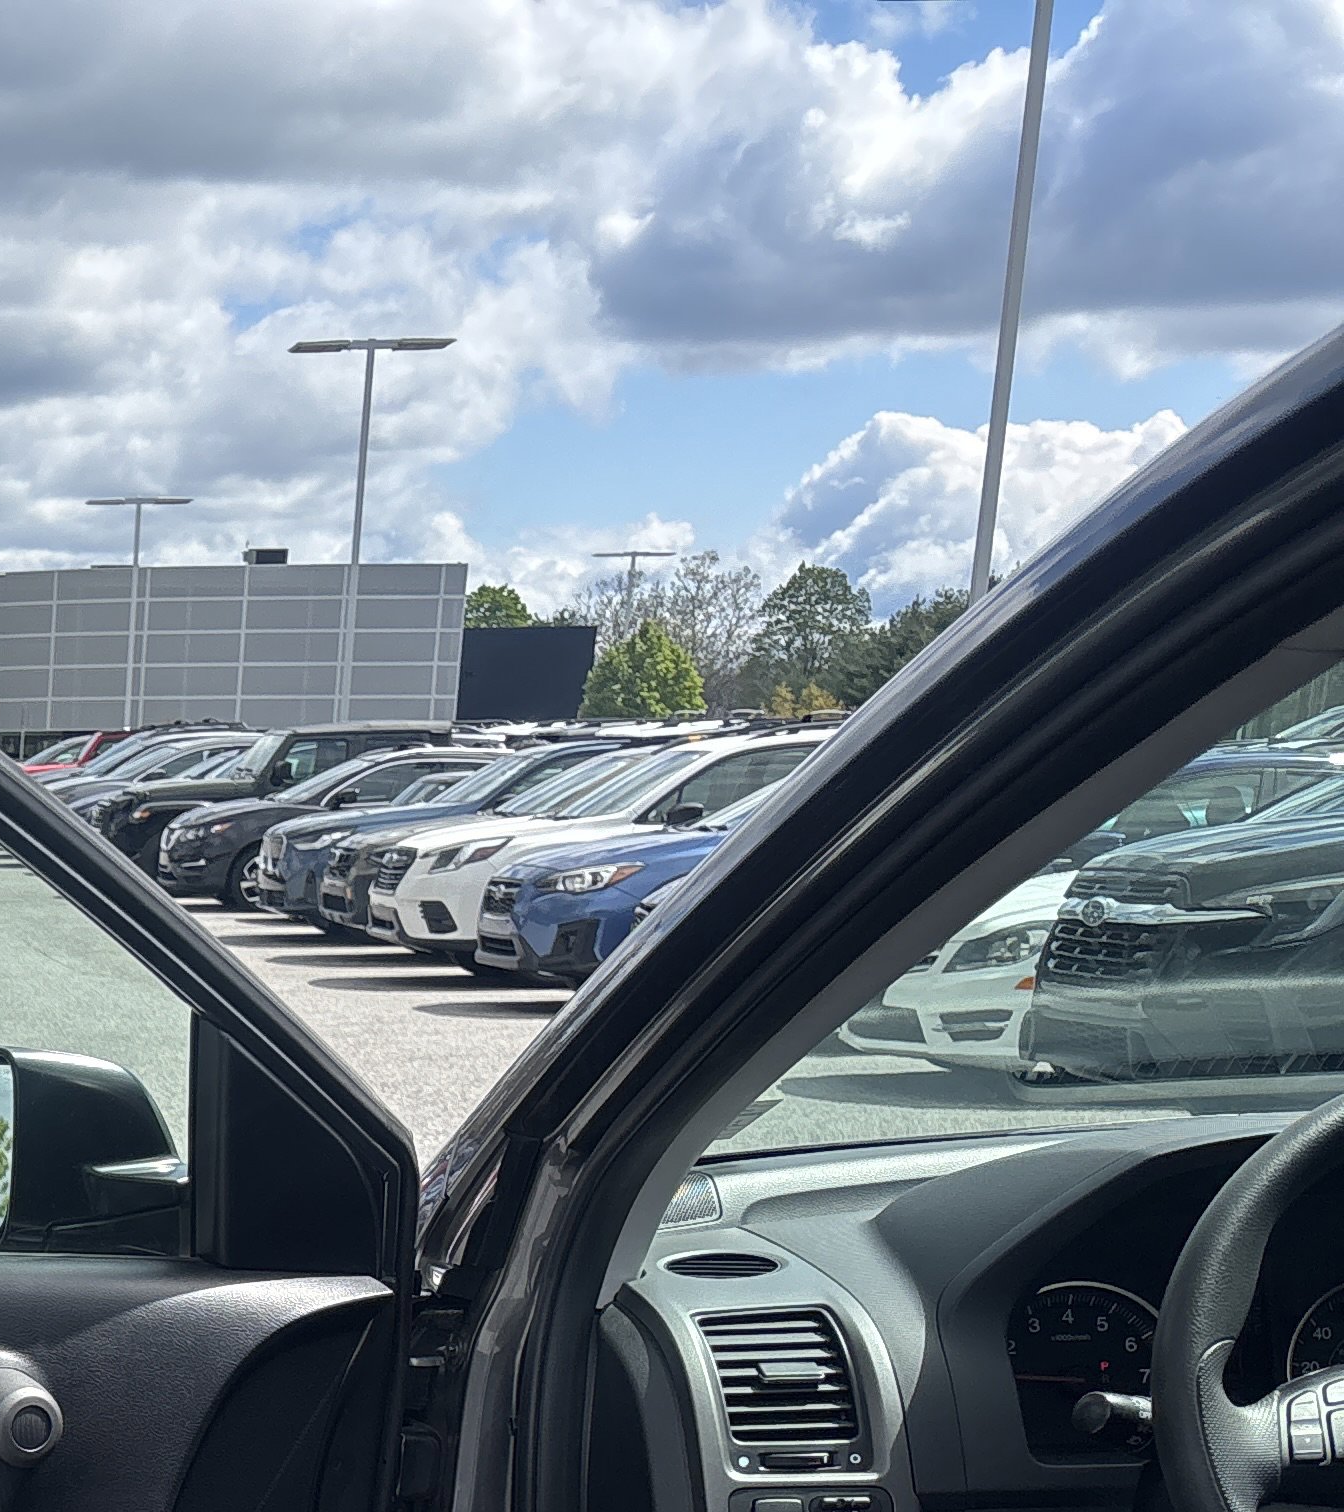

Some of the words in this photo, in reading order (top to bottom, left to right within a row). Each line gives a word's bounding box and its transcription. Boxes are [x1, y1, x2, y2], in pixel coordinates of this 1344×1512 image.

[1062, 1308, 1075, 1325] 4
[1028, 1318, 1041, 1333] 3
[1097, 1317, 1109, 1332] 5
[1313, 1327, 1332, 1340] 40
[1125, 1337, 1138, 1352] 6
[1100, 1361, 1110, 1372] P
[1139, 1368, 1150, 1384] 7
